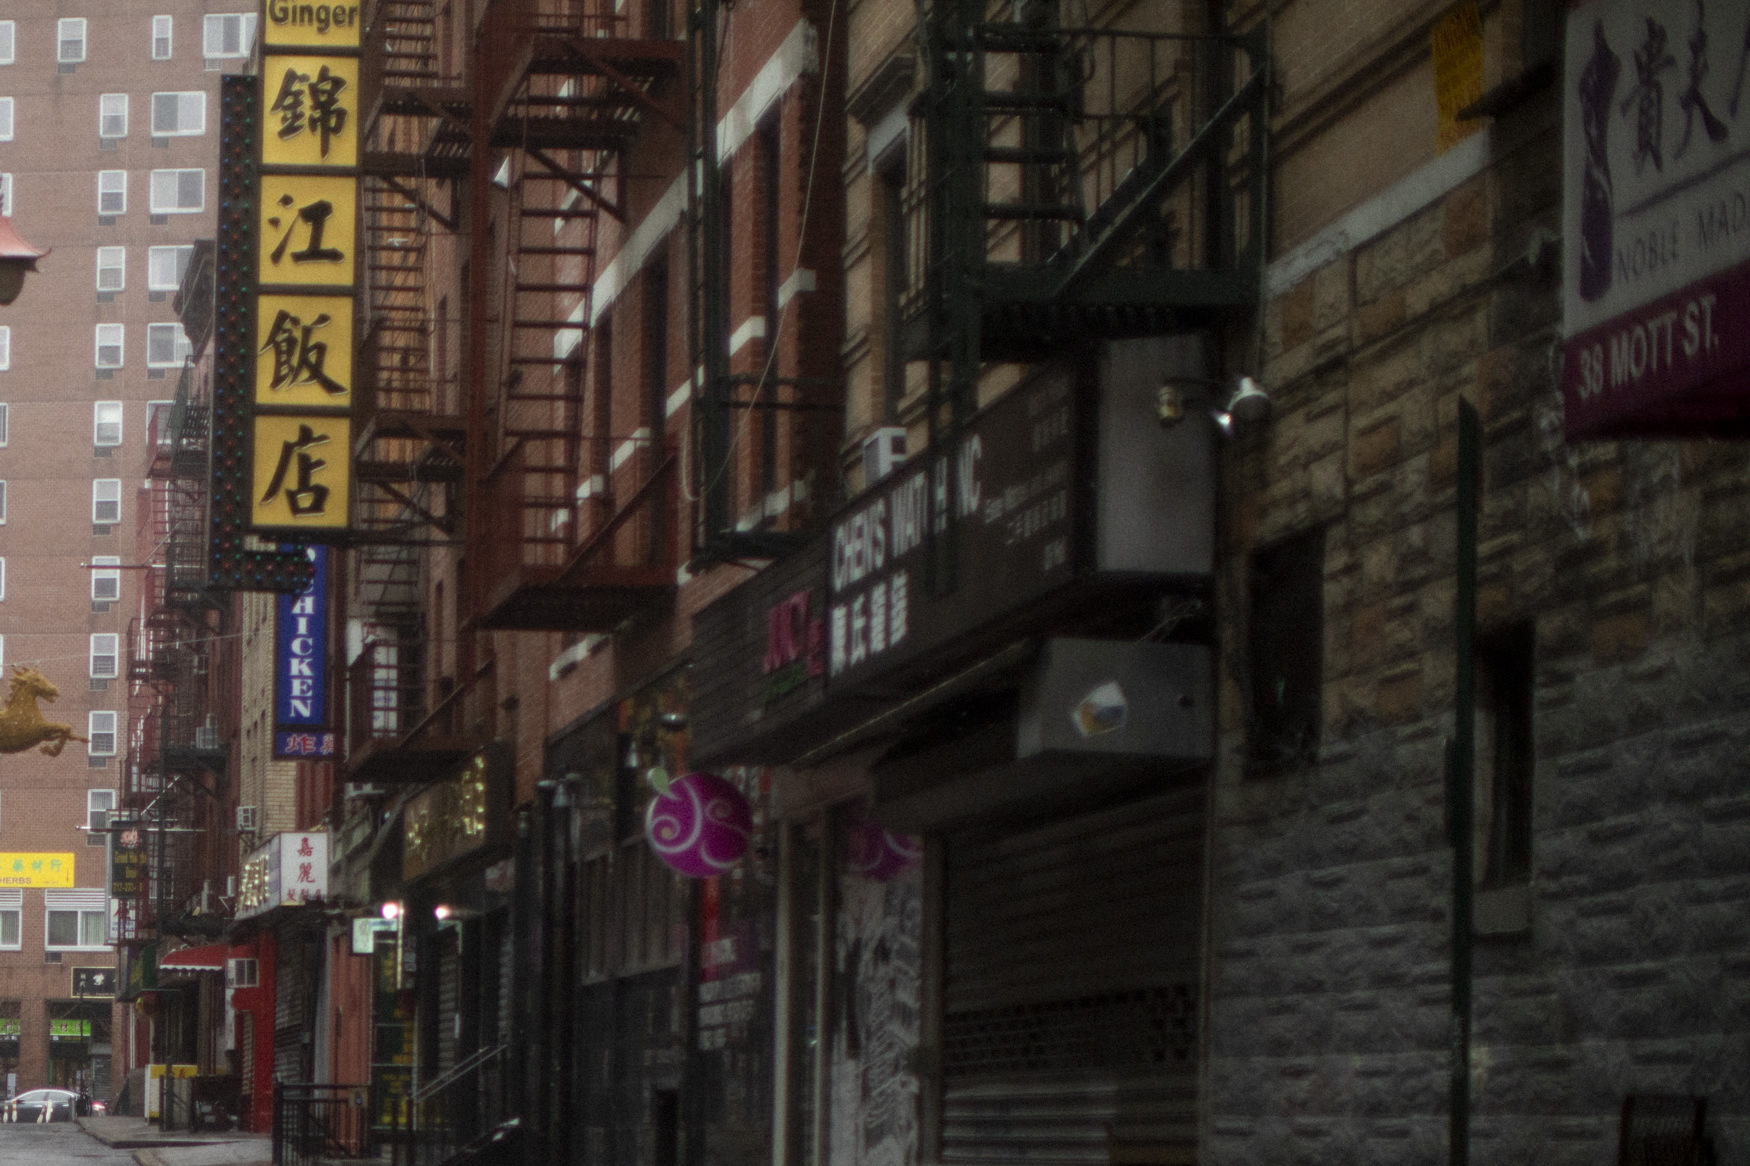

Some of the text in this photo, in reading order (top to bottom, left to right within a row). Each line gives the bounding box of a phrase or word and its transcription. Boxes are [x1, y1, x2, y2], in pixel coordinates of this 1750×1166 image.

[269, 0, 358, 34] Ginger
[259, 64, 349, 518] 錦江飯店
[1617, 220, 1680, 284] NOBLE
[1578, 295, 1720, 401] 38 MOTT ST.
[891, 456, 948, 560] WATH
[0, 877, 32, 885] HERBS
